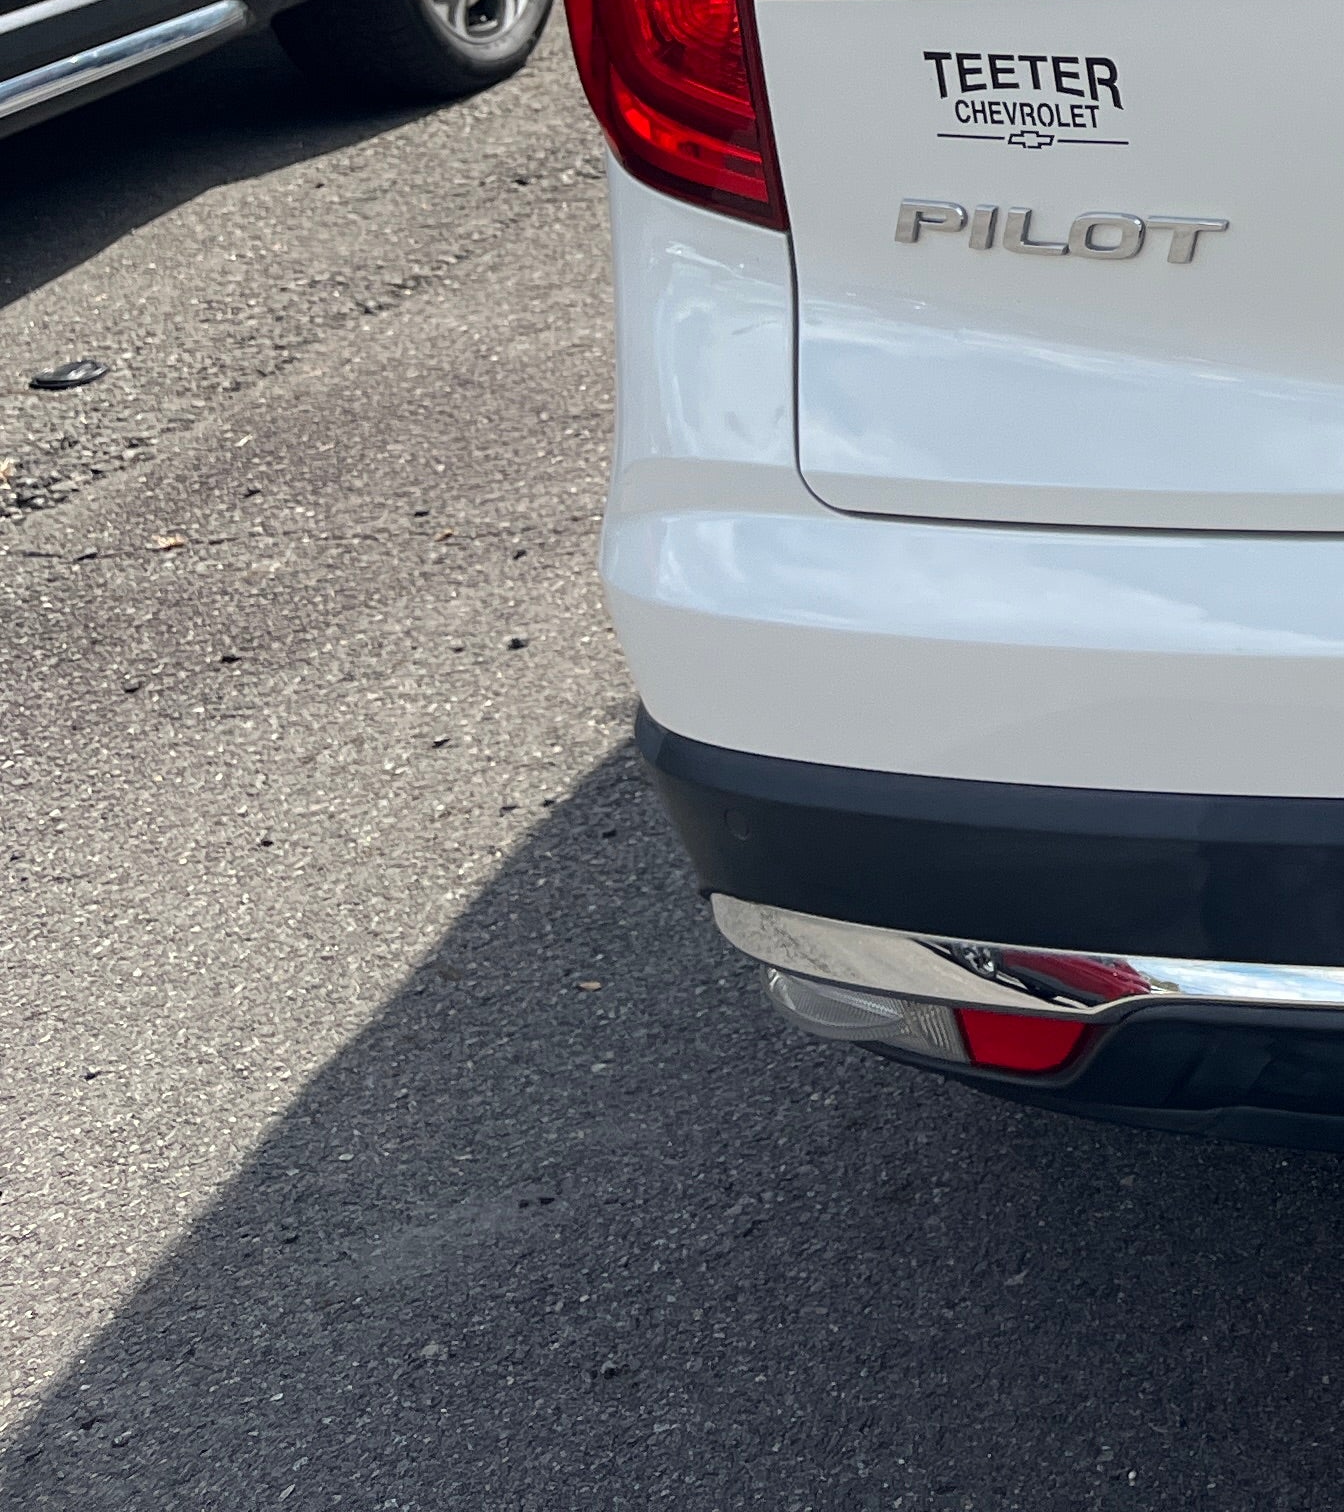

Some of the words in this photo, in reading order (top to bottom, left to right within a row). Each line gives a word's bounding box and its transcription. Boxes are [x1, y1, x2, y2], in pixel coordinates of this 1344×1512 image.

[923, 51, 1124, 110] TEETER
[954, 99, 1100, 129] CHEVROLET
[894, 198, 1230, 264] PILOT
